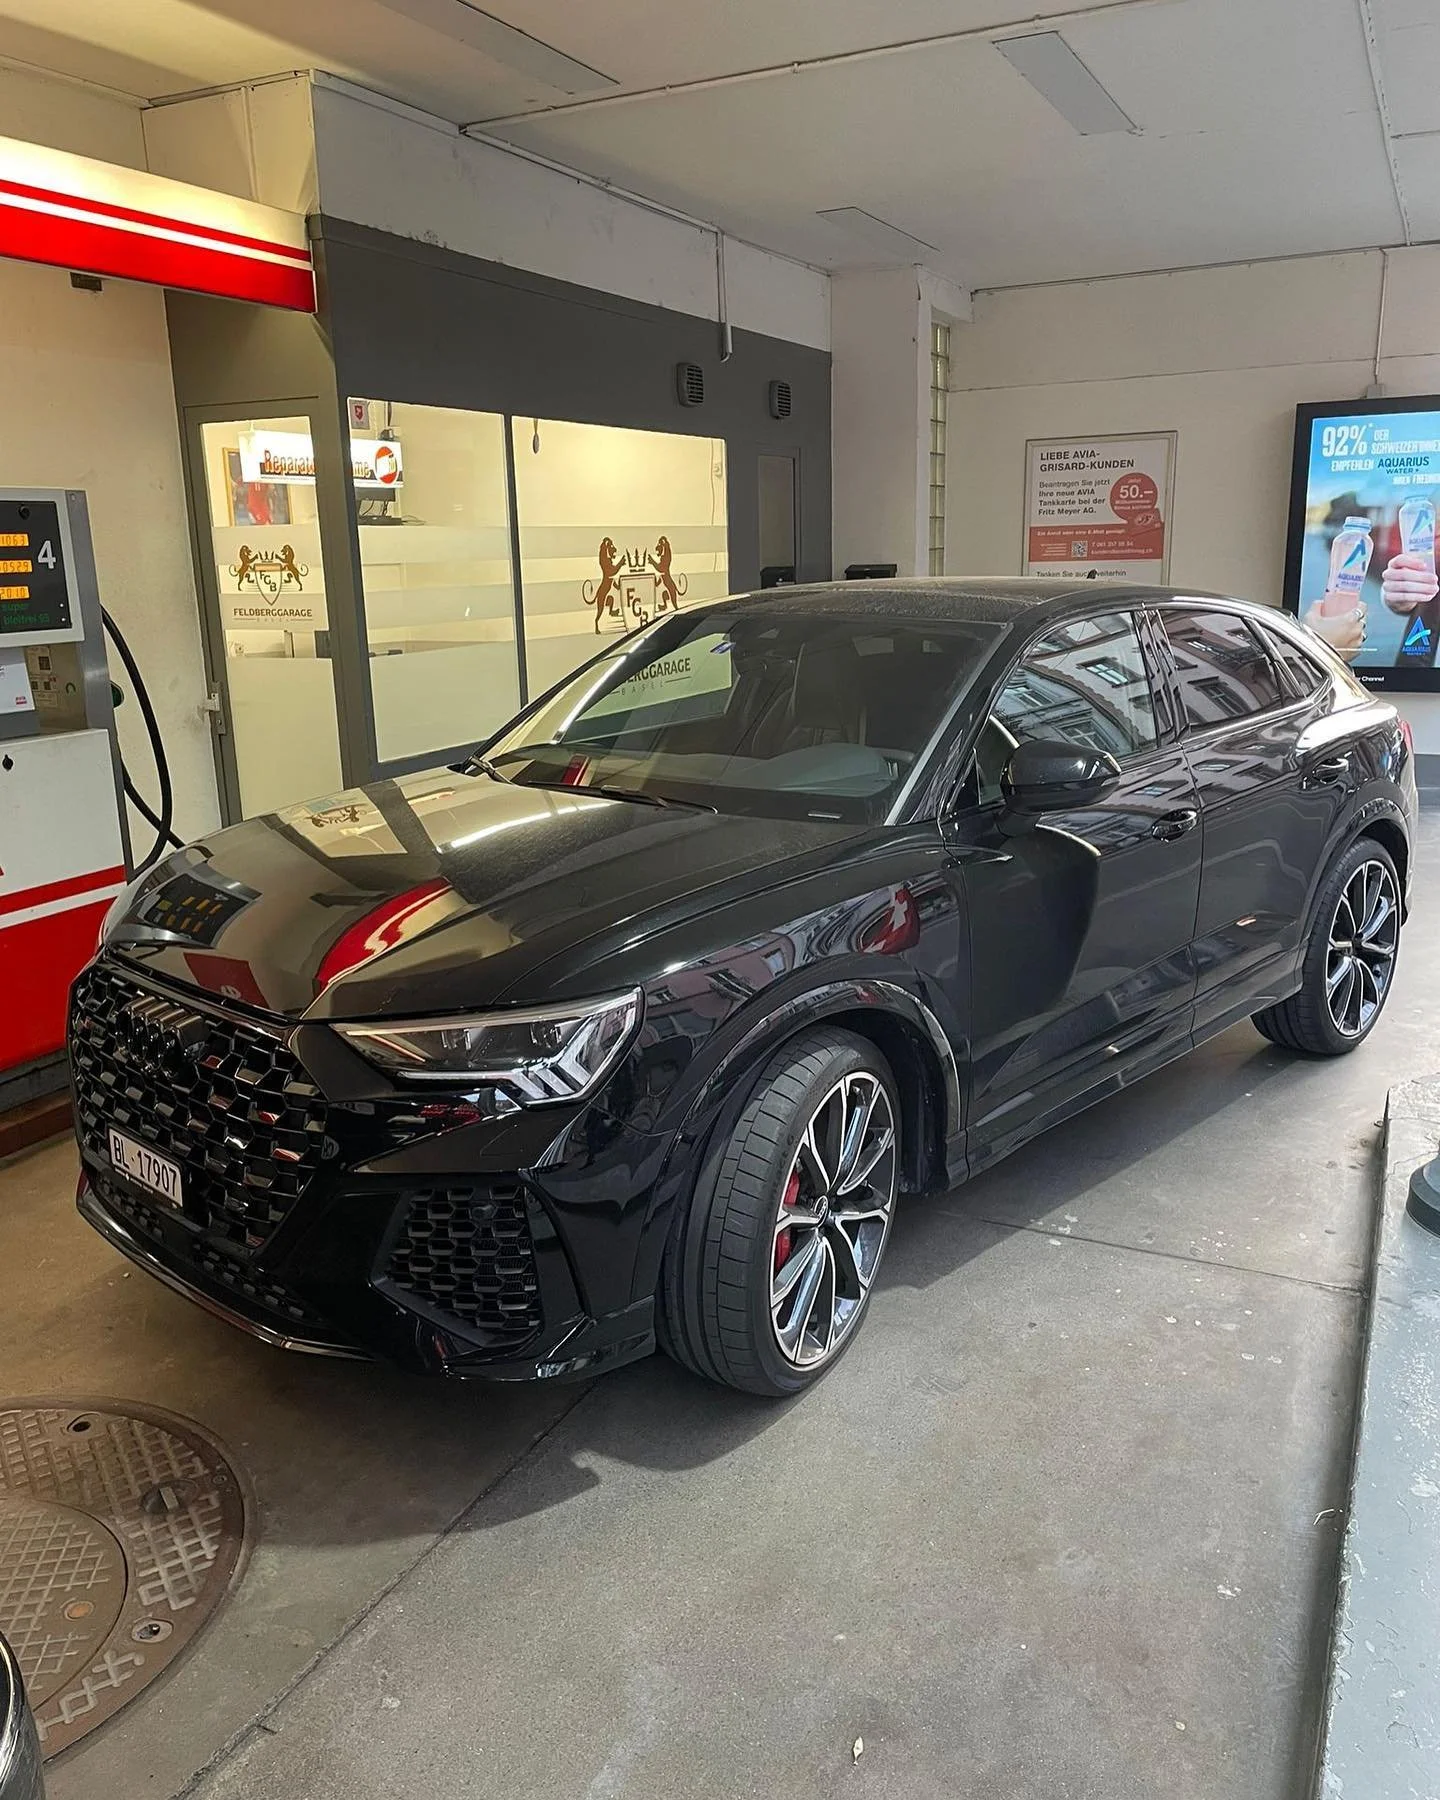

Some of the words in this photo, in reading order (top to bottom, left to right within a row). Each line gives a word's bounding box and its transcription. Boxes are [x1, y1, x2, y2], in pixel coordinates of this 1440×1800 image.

[1040, 451, 1070, 461] LIEBE
[1072, 450, 1101, 459] AVIA-
[1040, 459, 1135, 472] GRISARD-KUNDEN
[1377, 456, 1430, 468] AQUARIUS
[1039, 480, 1080, 488] Beantragen
[1094, 479, 1110, 487] jetzt
[1077, 488, 1095, 496] AVIA
[1038, 508, 1055, 516] Fritz
[1057, 508, 1081, 516] Meyer
[38, 540, 57, 569] 4
[233, 608, 313, 617] FELDBERGGARAGE
[113, 1135, 130, 1170] BL
[137, 1150, 177, 1197] 17907
